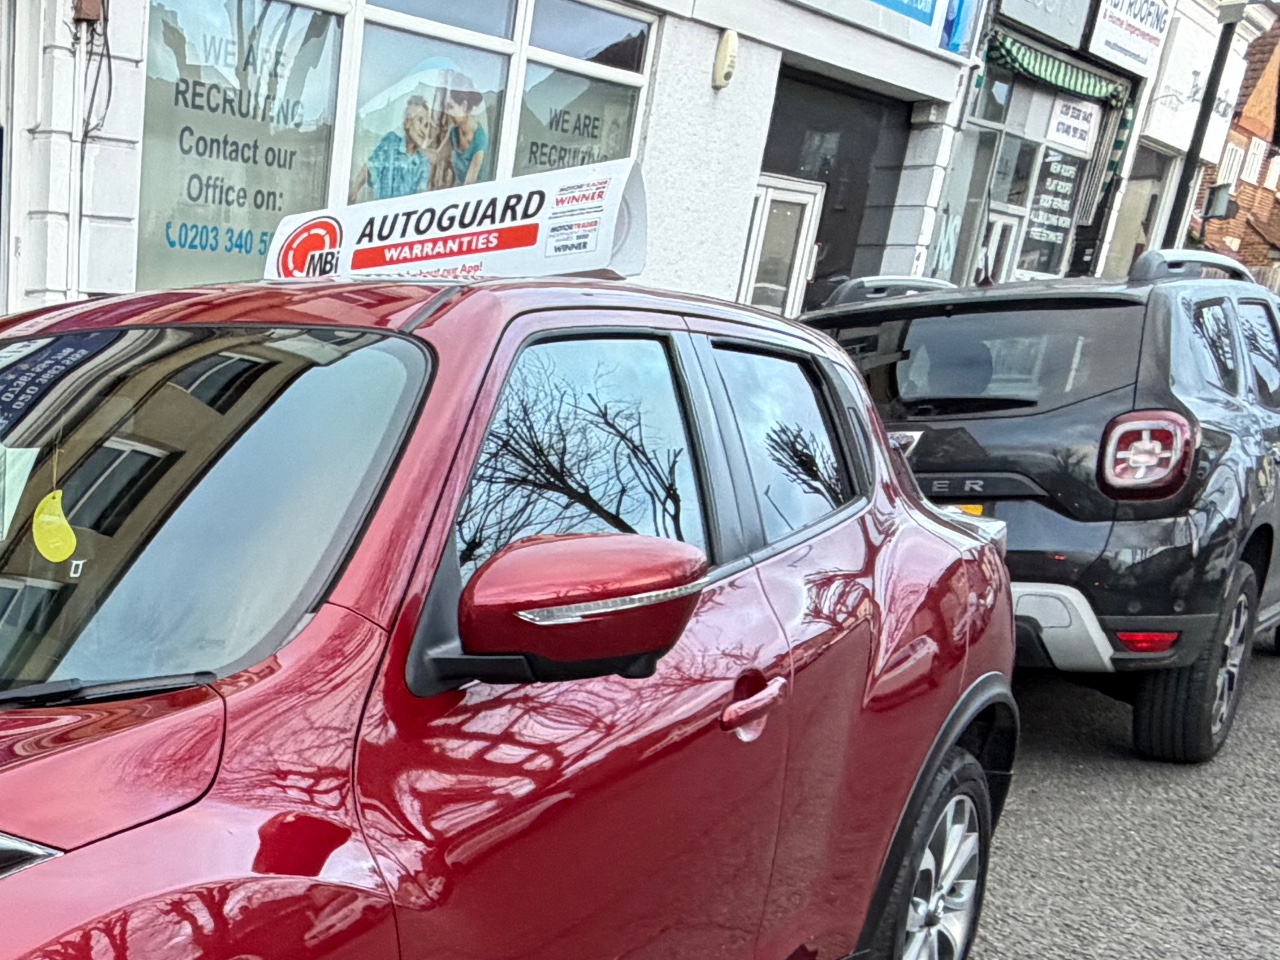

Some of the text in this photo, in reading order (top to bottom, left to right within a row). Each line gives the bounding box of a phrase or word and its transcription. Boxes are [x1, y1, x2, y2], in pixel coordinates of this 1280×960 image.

[549, 107, 599, 138] WE ARE
[179, 126, 297, 169] Contact our
[187, 174, 283, 211] Office on:
[555, 190, 605, 207] WINNER
[356, 190, 546, 245] AUTOGUARD
[178, 223, 219, 251] 0203
[224, 228, 253, 254] 340
[384, 232, 499, 262] WARRANTIES
[554, 241, 588, 253] WINNER
[306, 250, 340, 277] MBi
